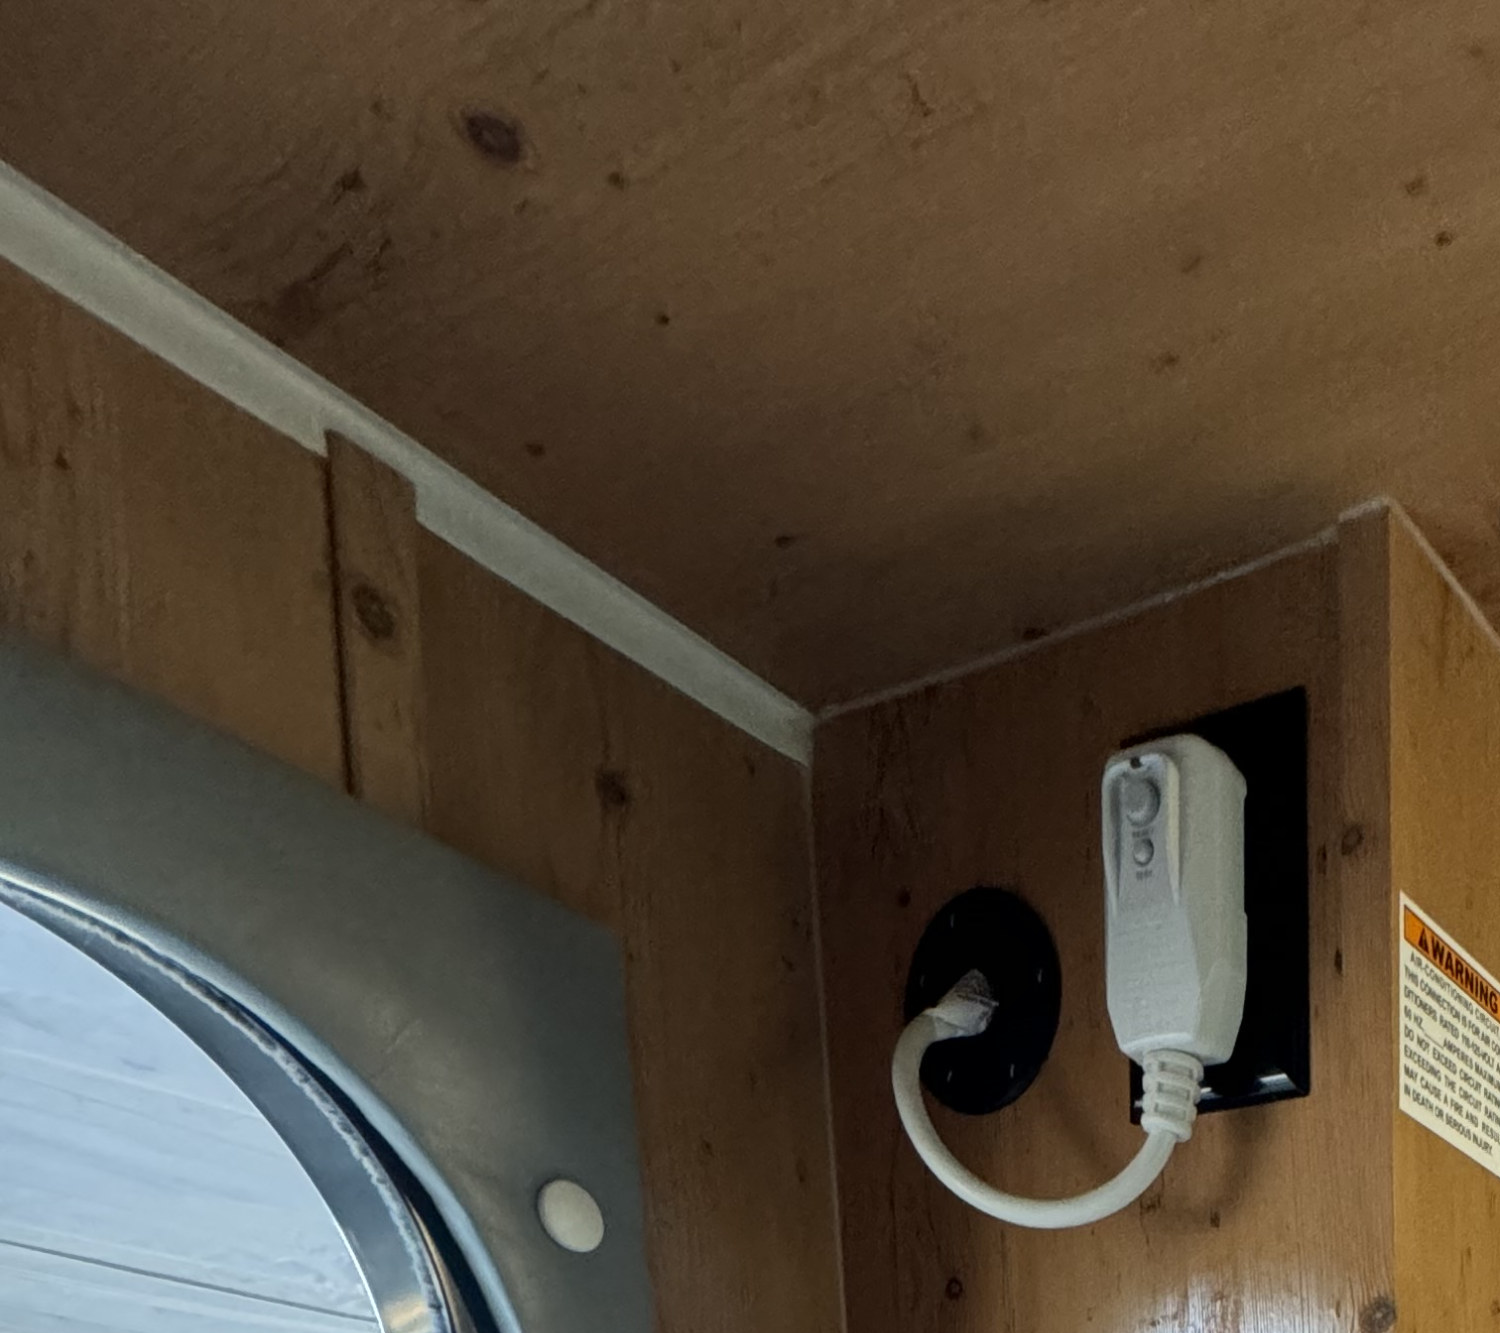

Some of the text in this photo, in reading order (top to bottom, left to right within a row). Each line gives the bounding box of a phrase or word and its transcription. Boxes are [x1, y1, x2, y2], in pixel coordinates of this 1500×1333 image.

[1404, 965, 1418, 987] THIS
[1420, 978, 1460, 1023] CONNECTION
[1468, 1019, 1479, 1039] FOR
[1481, 1030, 1490, 1048] AIR
[1431, 933, 1498, 1016] WARNING
[1404, 984, 1437, 1023] DITIONERS
[1439, 1014, 1459, 1041] RATED
[1404, 1024, 1413, 1043] DO
[1416, 1034, 1429, 1055] NOT
[1432, 1046, 1456, 1076] EXCEED
[1459, 1067, 1481, 1095] CIRCUIT
[1404, 1043, 1441, 1082] EXCEEDING
[1444, 1074, 1456, 1094] THE
[1458, 1085, 1481, 1113] CIRCUIT
[1443, 1035, 1473, 1070] AMPERES
[1404, 1063, 1417, 1084] MAY
[1420, 1075, 1441, 1101] CAUSE
[1450, 1097, 1463, 1117] FIRE
[1465, 1108, 1478, 1128] AND
[1412, 1088, 1433, 1114] DEATH
[1435, 1104, 1443, 1122] OR
[1445, 1112, 1470, 1141] SERIOUS
